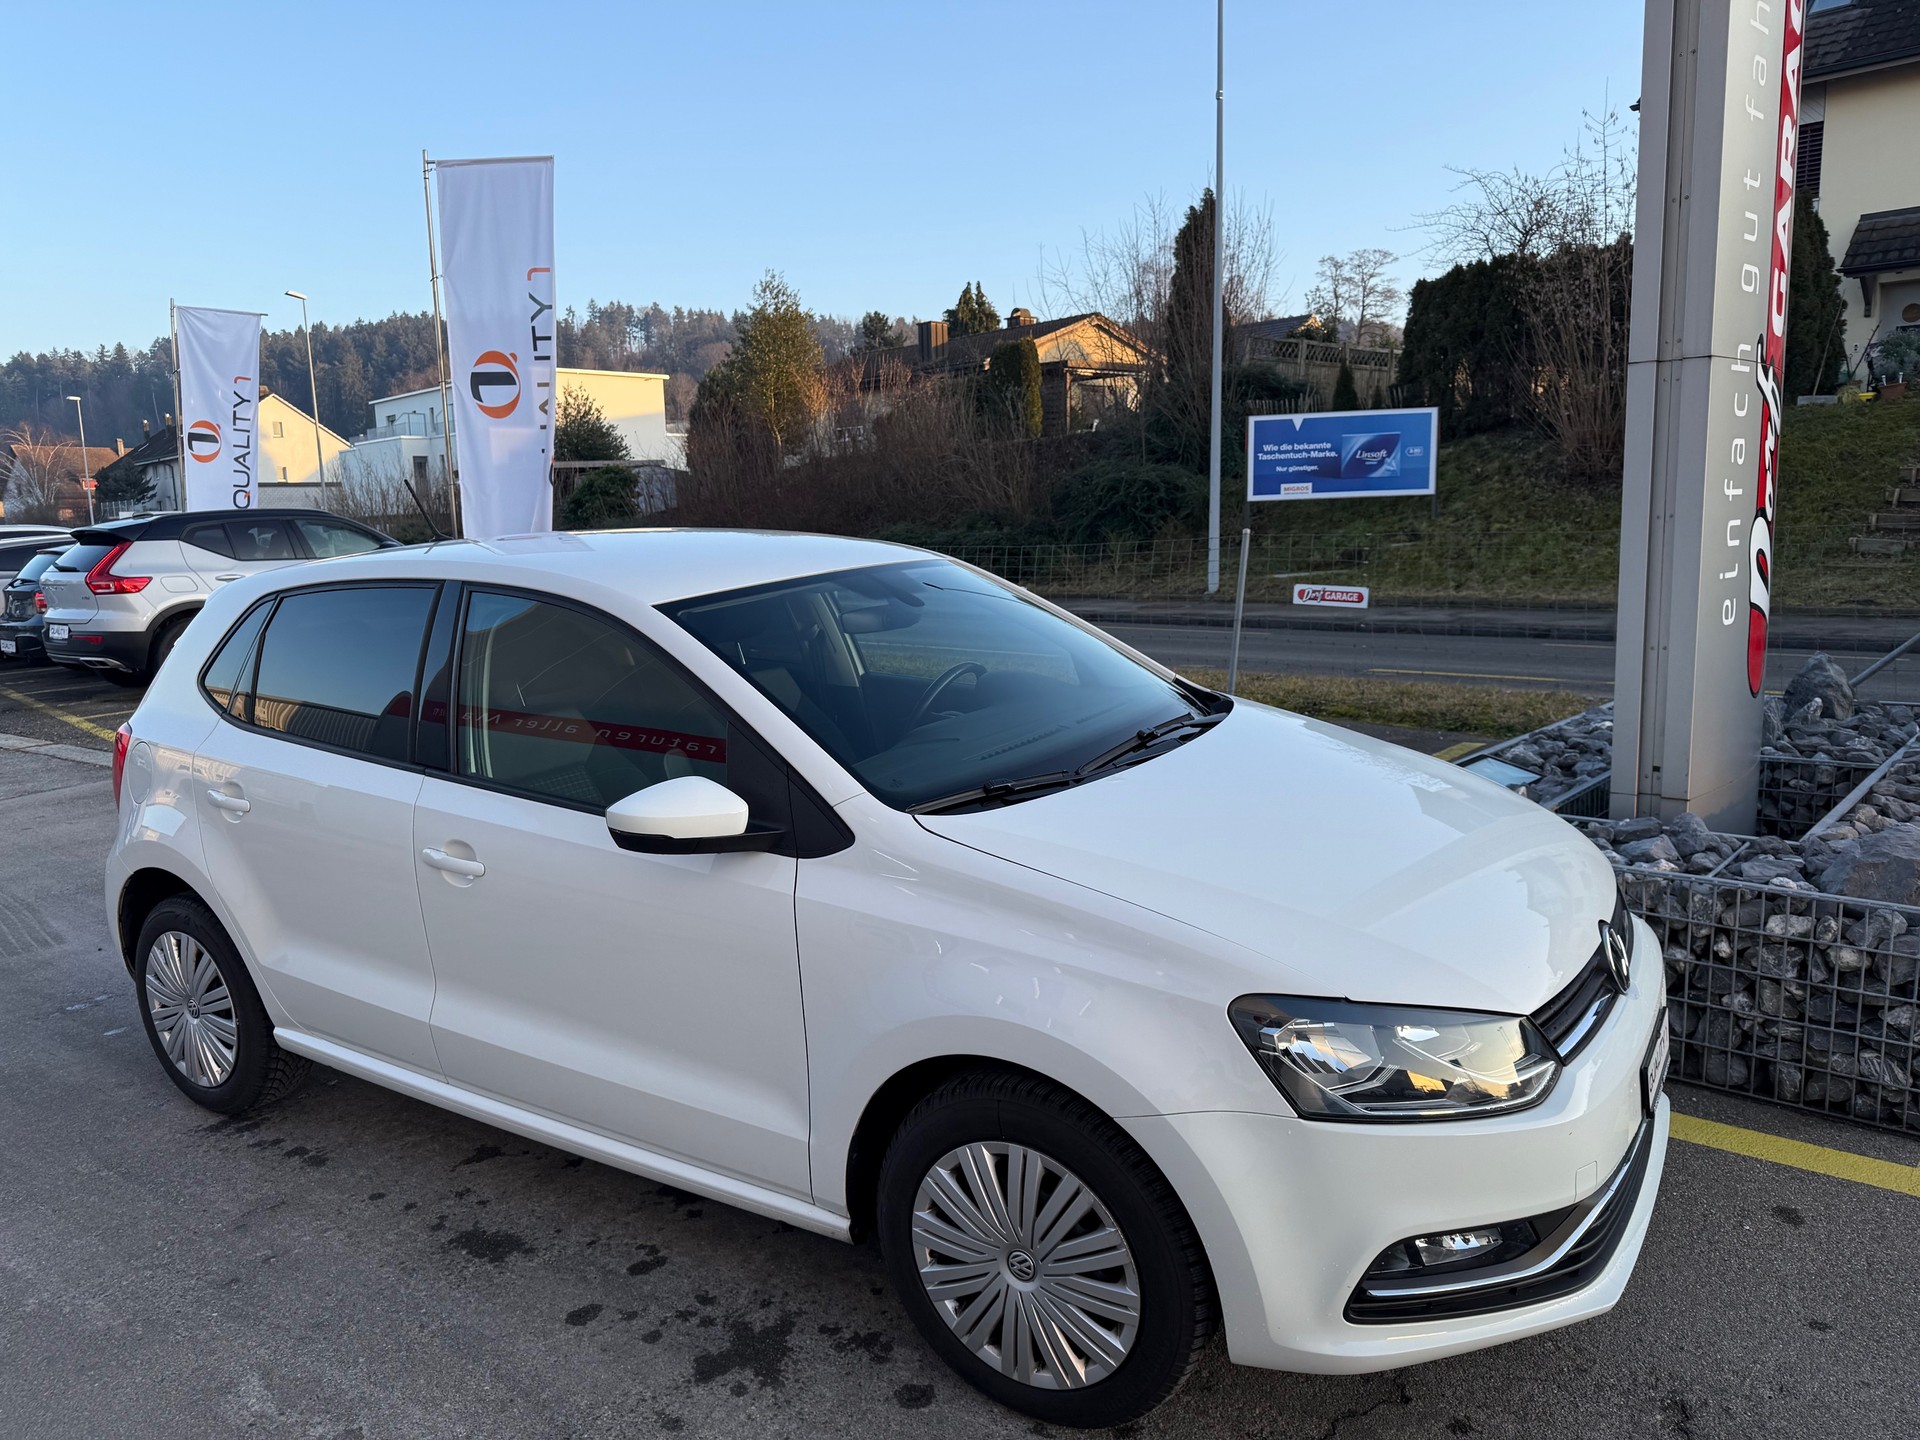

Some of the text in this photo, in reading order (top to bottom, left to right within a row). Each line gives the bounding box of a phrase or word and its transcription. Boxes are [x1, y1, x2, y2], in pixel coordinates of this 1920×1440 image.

[1719, 343, 1751, 626] einfach
[1741, 168, 1762, 294] gut
[232, 390, 251, 509] QUALITY
[1263, 442, 1332, 452] Wie die bekannte
[1257, 450, 1338, 460] Taschentuch-Marke.
[1356, 449, 1388, 461] Linsoft
[1325, 591, 1359, 602] GARAGE
